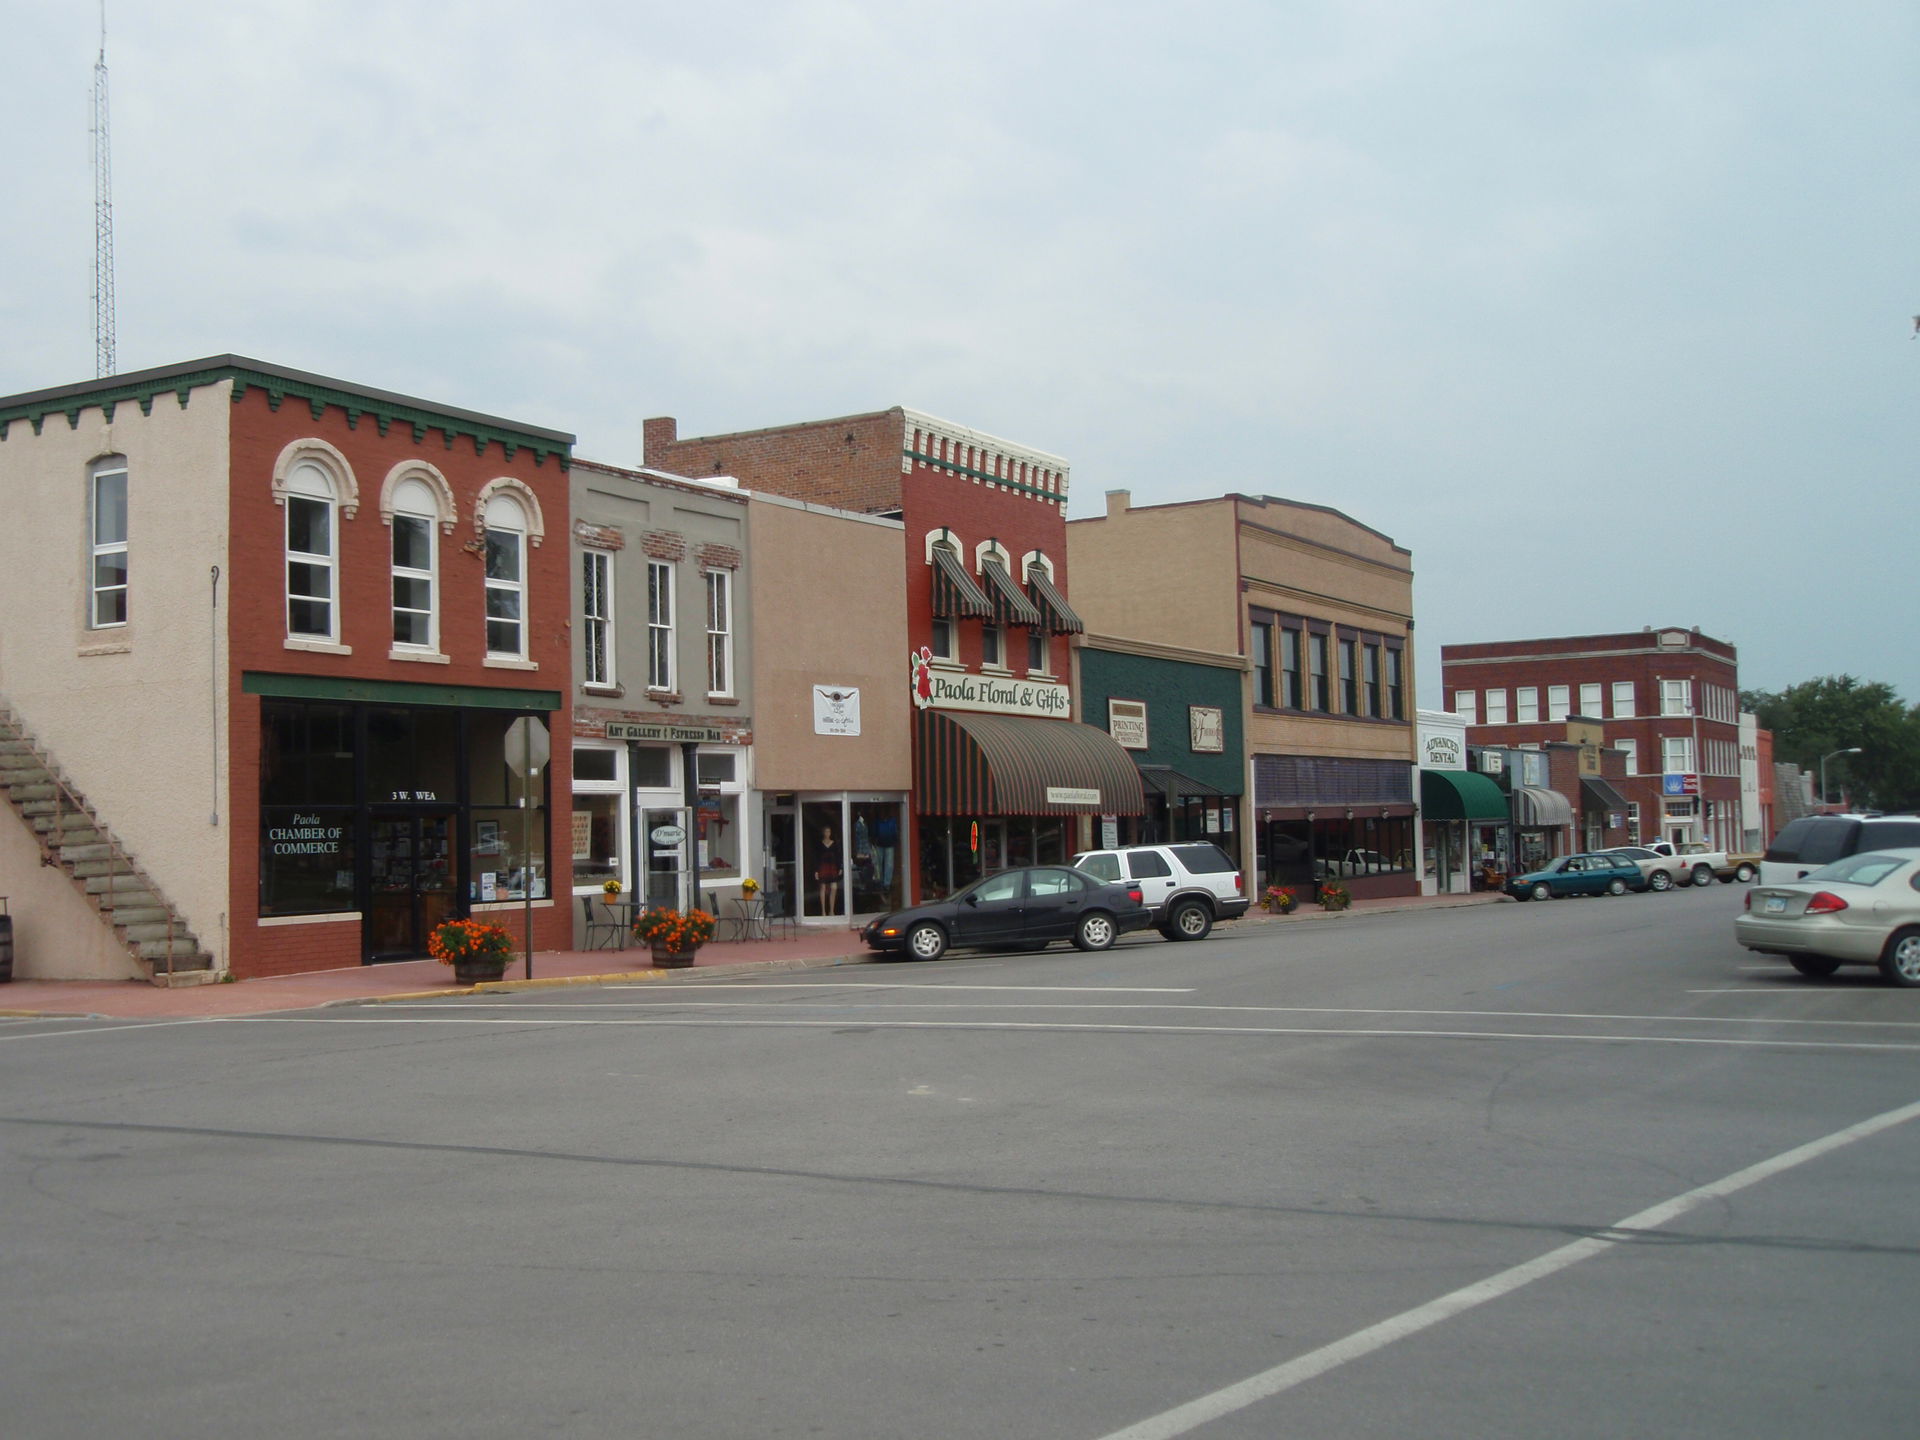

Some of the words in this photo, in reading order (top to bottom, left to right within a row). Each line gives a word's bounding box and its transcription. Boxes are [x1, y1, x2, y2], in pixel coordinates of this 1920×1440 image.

[934, 678, 976, 701] Paola
[978, 681, 1019, 705] Floral
[1020, 687, 1034, 706] &
[1036, 688, 1065, 714] Gifts
[1113, 720, 1144, 732] PRINTING
[1426, 736, 1460, 754] ADVANCED
[1430, 751, 1456, 764] DENTAL
[392, 791, 398, 800] 3
[398, 791, 411, 800] W.
[416, 791, 436, 801] WEA
[293, 813, 320, 825] Paola
[269, 827, 326, 840] CHAMBER
[328, 827, 343, 839] OF
[274, 841, 340, 855] COMMERCE
